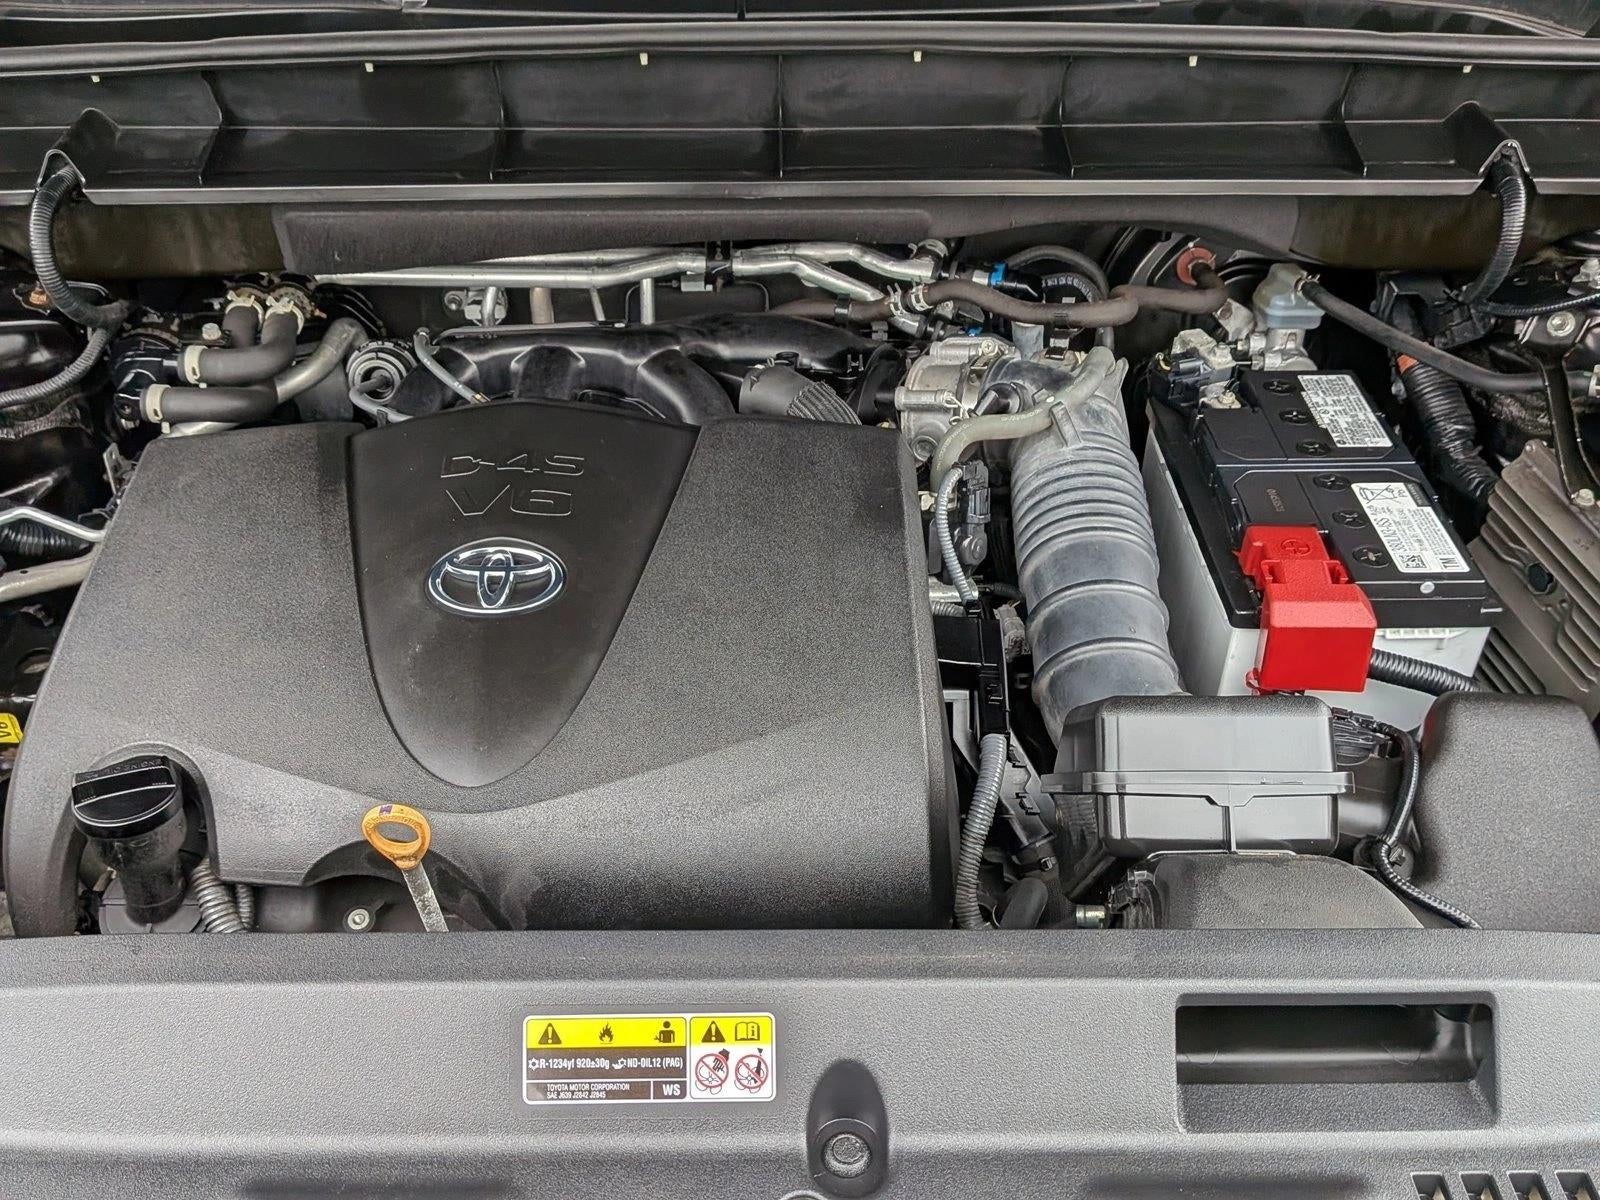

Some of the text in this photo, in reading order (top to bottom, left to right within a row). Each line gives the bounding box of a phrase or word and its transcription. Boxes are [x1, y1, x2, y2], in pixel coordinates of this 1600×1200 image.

[440, 454, 585, 477] D-4S
[445, 484, 573, 516] V6
[662, 1056, 684, 1069] (PAG)
[546, 1082, 630, 1092] TOYOTA MOTOR CORPORATION
[662, 1083, 681, 1096] WS
[546, 1091, 558, 1099] SAE
